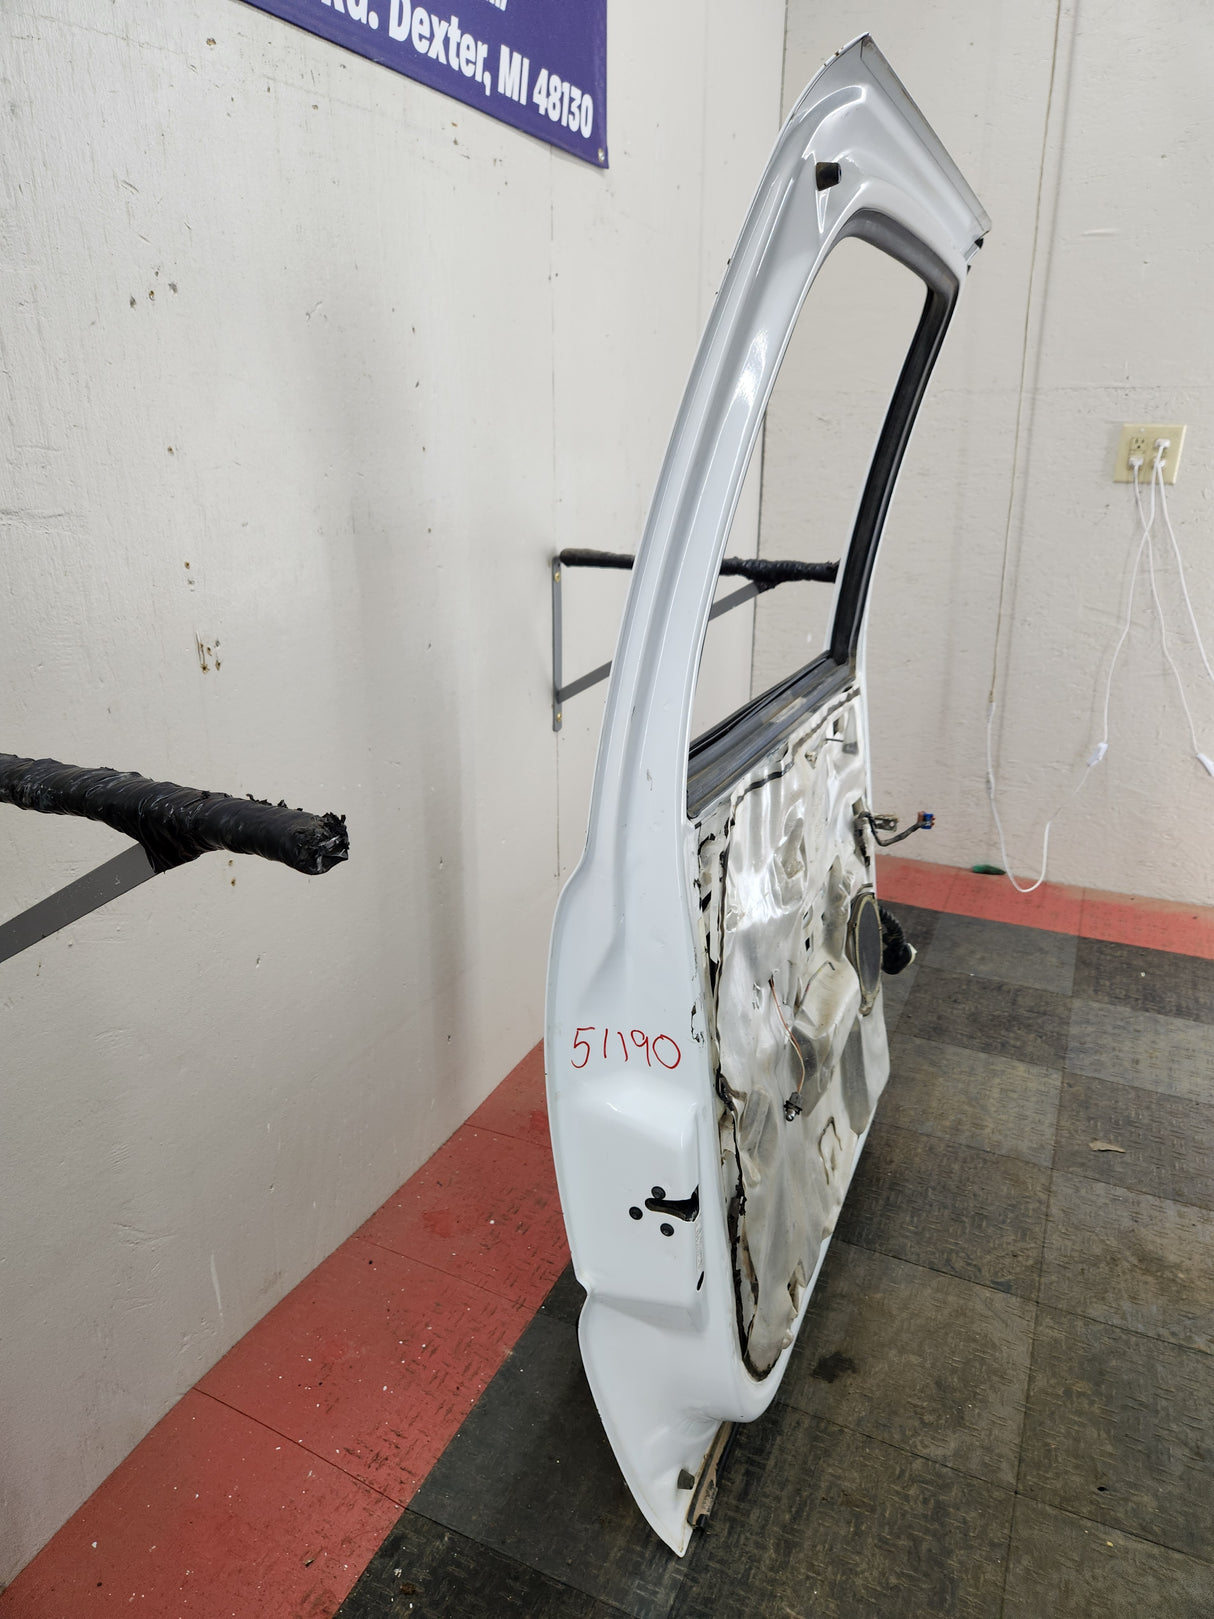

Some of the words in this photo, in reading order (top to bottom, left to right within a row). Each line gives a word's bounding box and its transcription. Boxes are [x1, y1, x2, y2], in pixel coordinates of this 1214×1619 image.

[388, 0, 492, 97] Dexter,
[497, 43, 531, 106] MI
[532, 67, 594, 139] 48130
[570, 1026, 682, 1070] 51190
